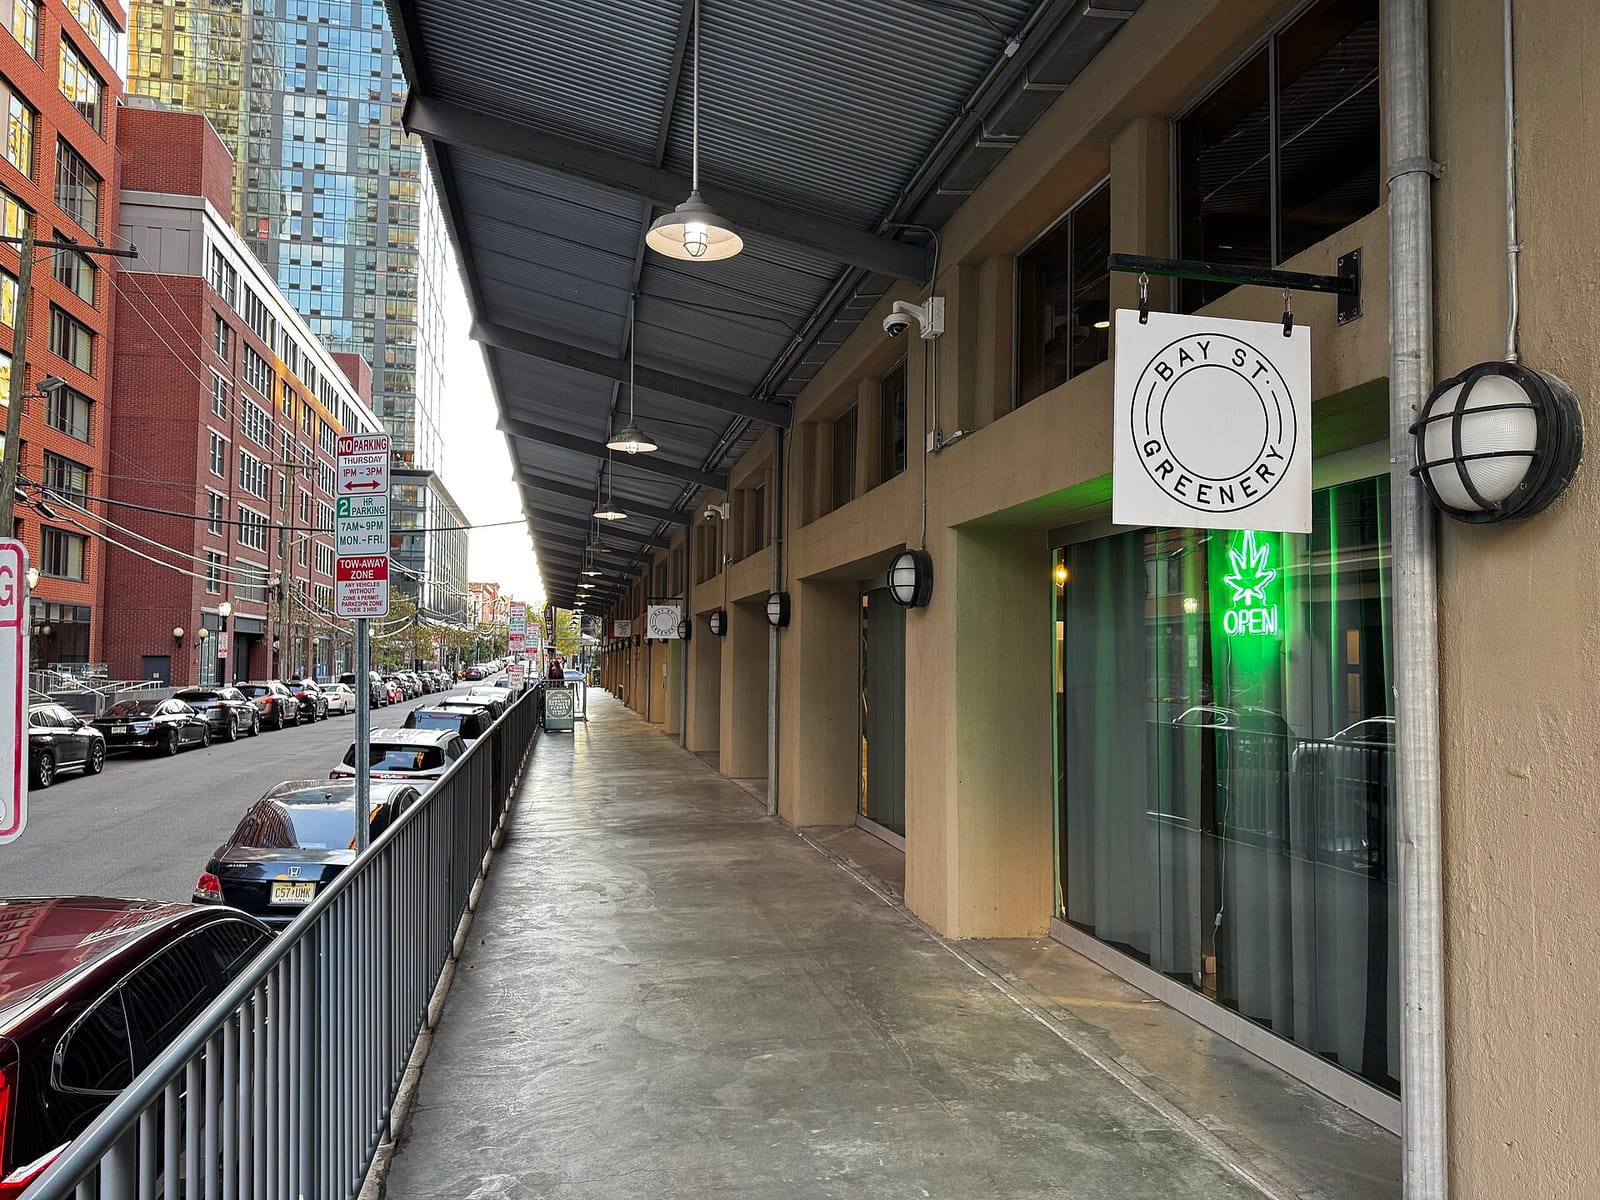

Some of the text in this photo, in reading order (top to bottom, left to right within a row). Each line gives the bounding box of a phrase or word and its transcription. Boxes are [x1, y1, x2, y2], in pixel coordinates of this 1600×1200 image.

[1154, 340, 1270, 385] BAY ST.
[338, 438, 386, 453] NO PARKING
[344, 456, 382, 464] THURSDAY
[344, 468, 356, 477] 1PM
[366, 468, 382, 476] 3PM
[1143, 439, 1284, 505] GREENERY
[340, 498, 374, 515] 2 HR
[352, 506, 384, 516] PARKING
[340, 558, 386, 568] TOW-AWAY
[350, 570, 374, 580] ZONE
[1224, 604, 1278, 636] OPEN
